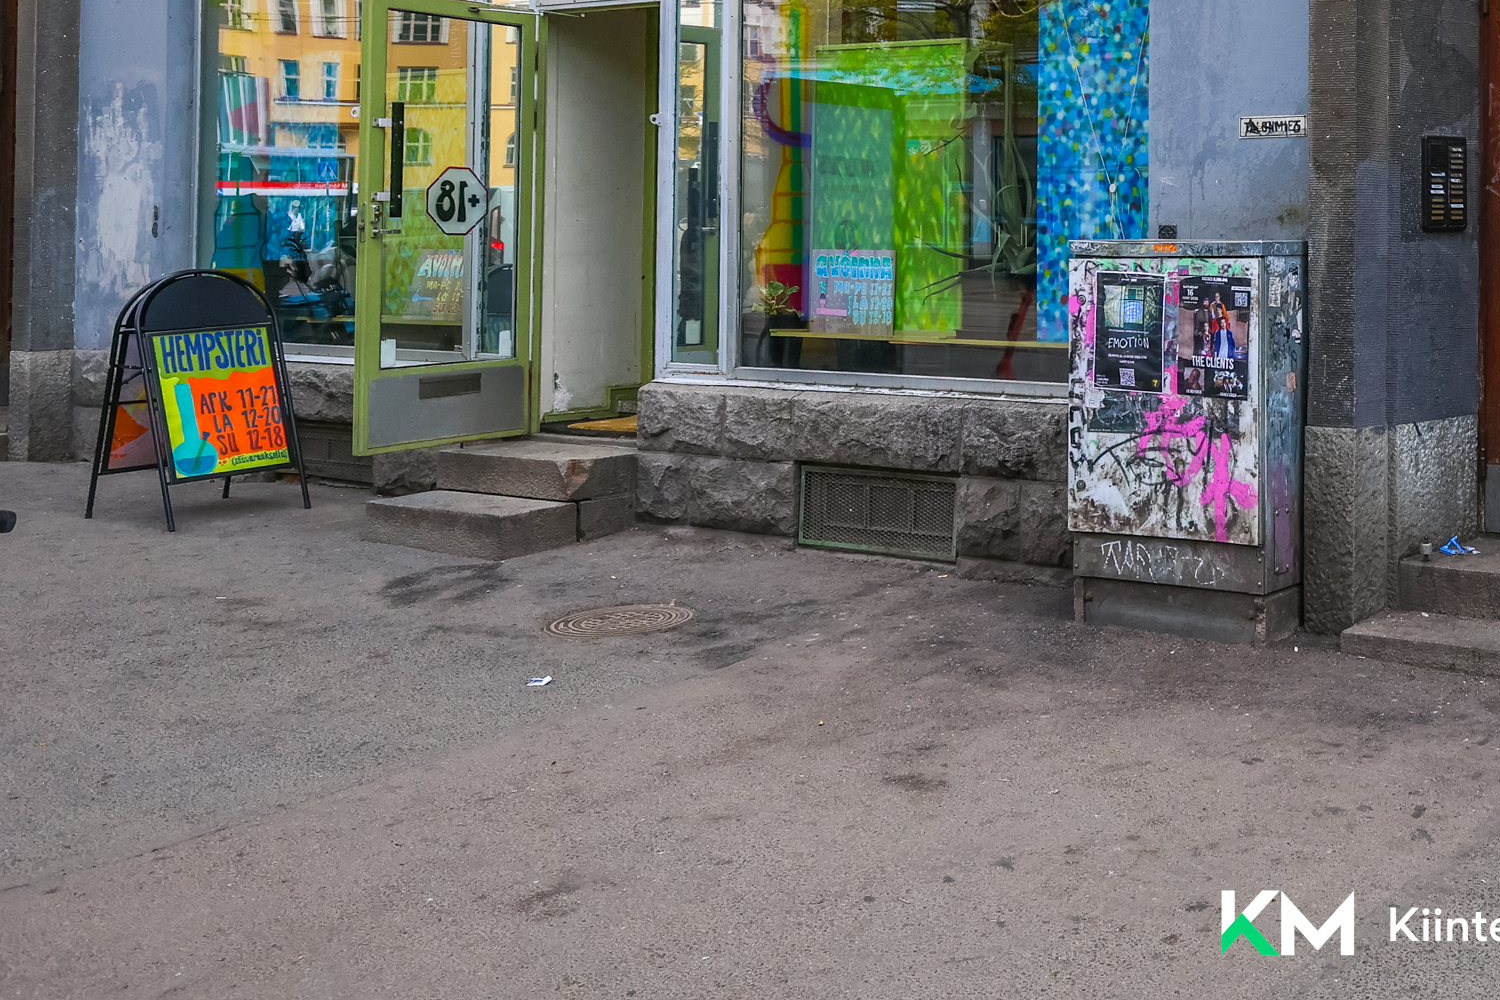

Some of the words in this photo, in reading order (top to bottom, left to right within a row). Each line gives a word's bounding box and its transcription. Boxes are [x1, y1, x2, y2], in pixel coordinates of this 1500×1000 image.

[1187, 289, 1194, 297] 16
[1107, 334, 1150, 349] EMOTION
[1191, 355, 1205, 367] THE
[1205, 356, 1235, 370] CLIENTS
[236, 385, 277, 409] 11-21
[213, 414, 233, 433] LA
[241, 405, 282, 428] 12-20
[217, 432, 239, 455] SU
[247, 425, 283, 450] 12-18
